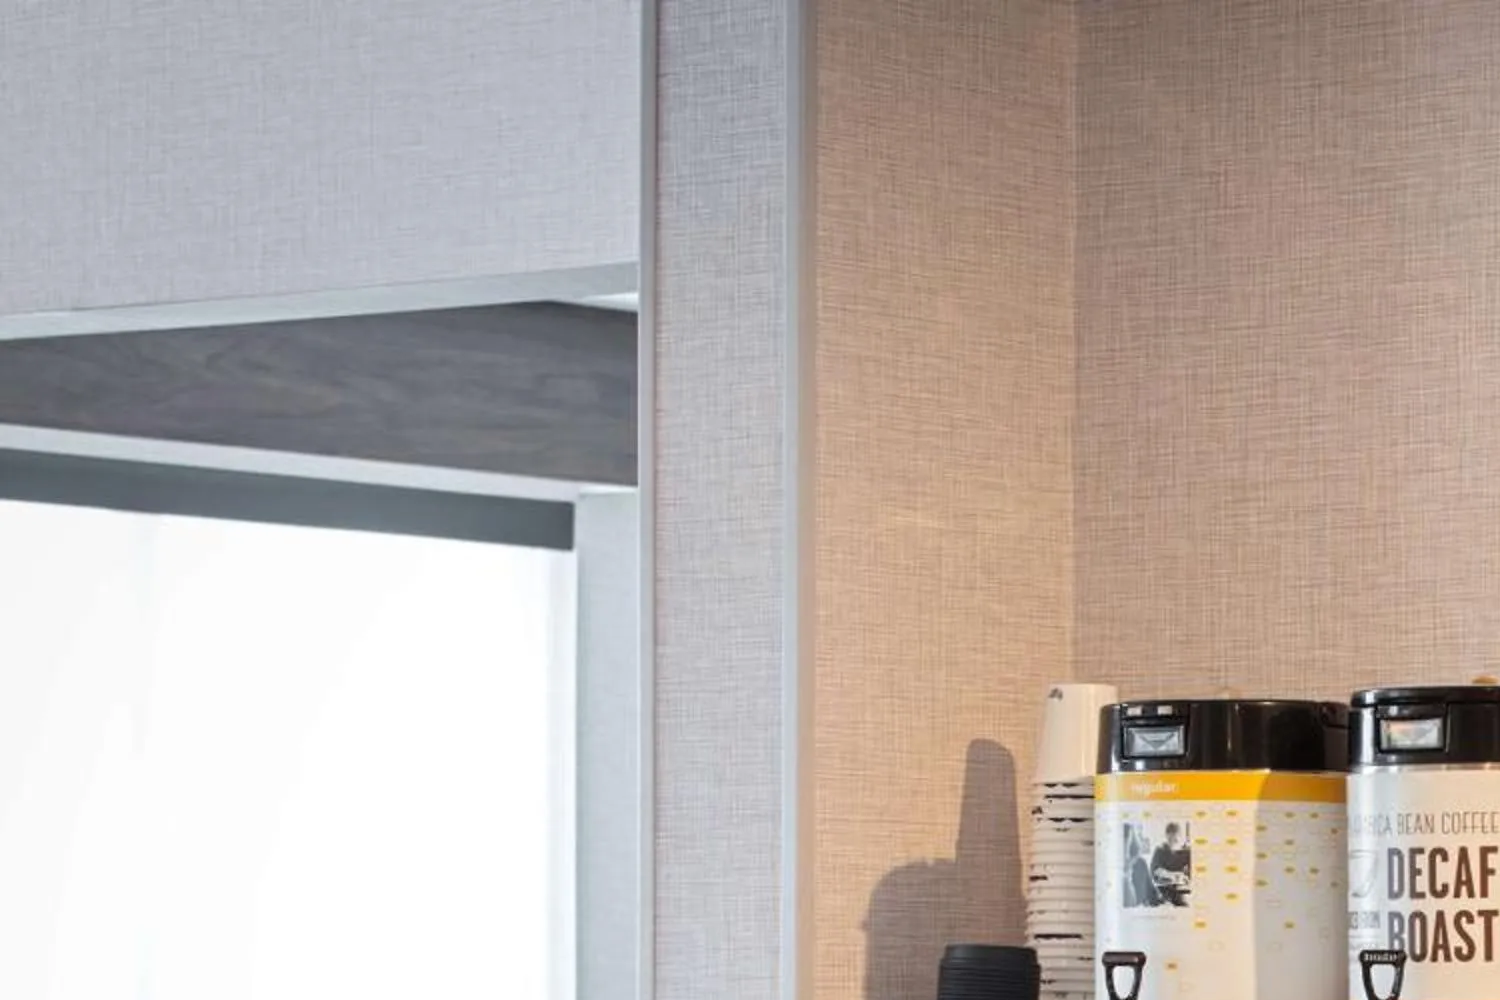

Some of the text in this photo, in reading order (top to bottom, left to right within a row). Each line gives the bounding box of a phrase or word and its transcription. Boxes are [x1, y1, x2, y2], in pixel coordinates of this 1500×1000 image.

[1397, 812, 1435, 835] BEAN
[1441, 811, 1500, 834] COFFEE
[1387, 845, 1499, 899] DECAF
[1387, 909, 1500, 963] ROAST
